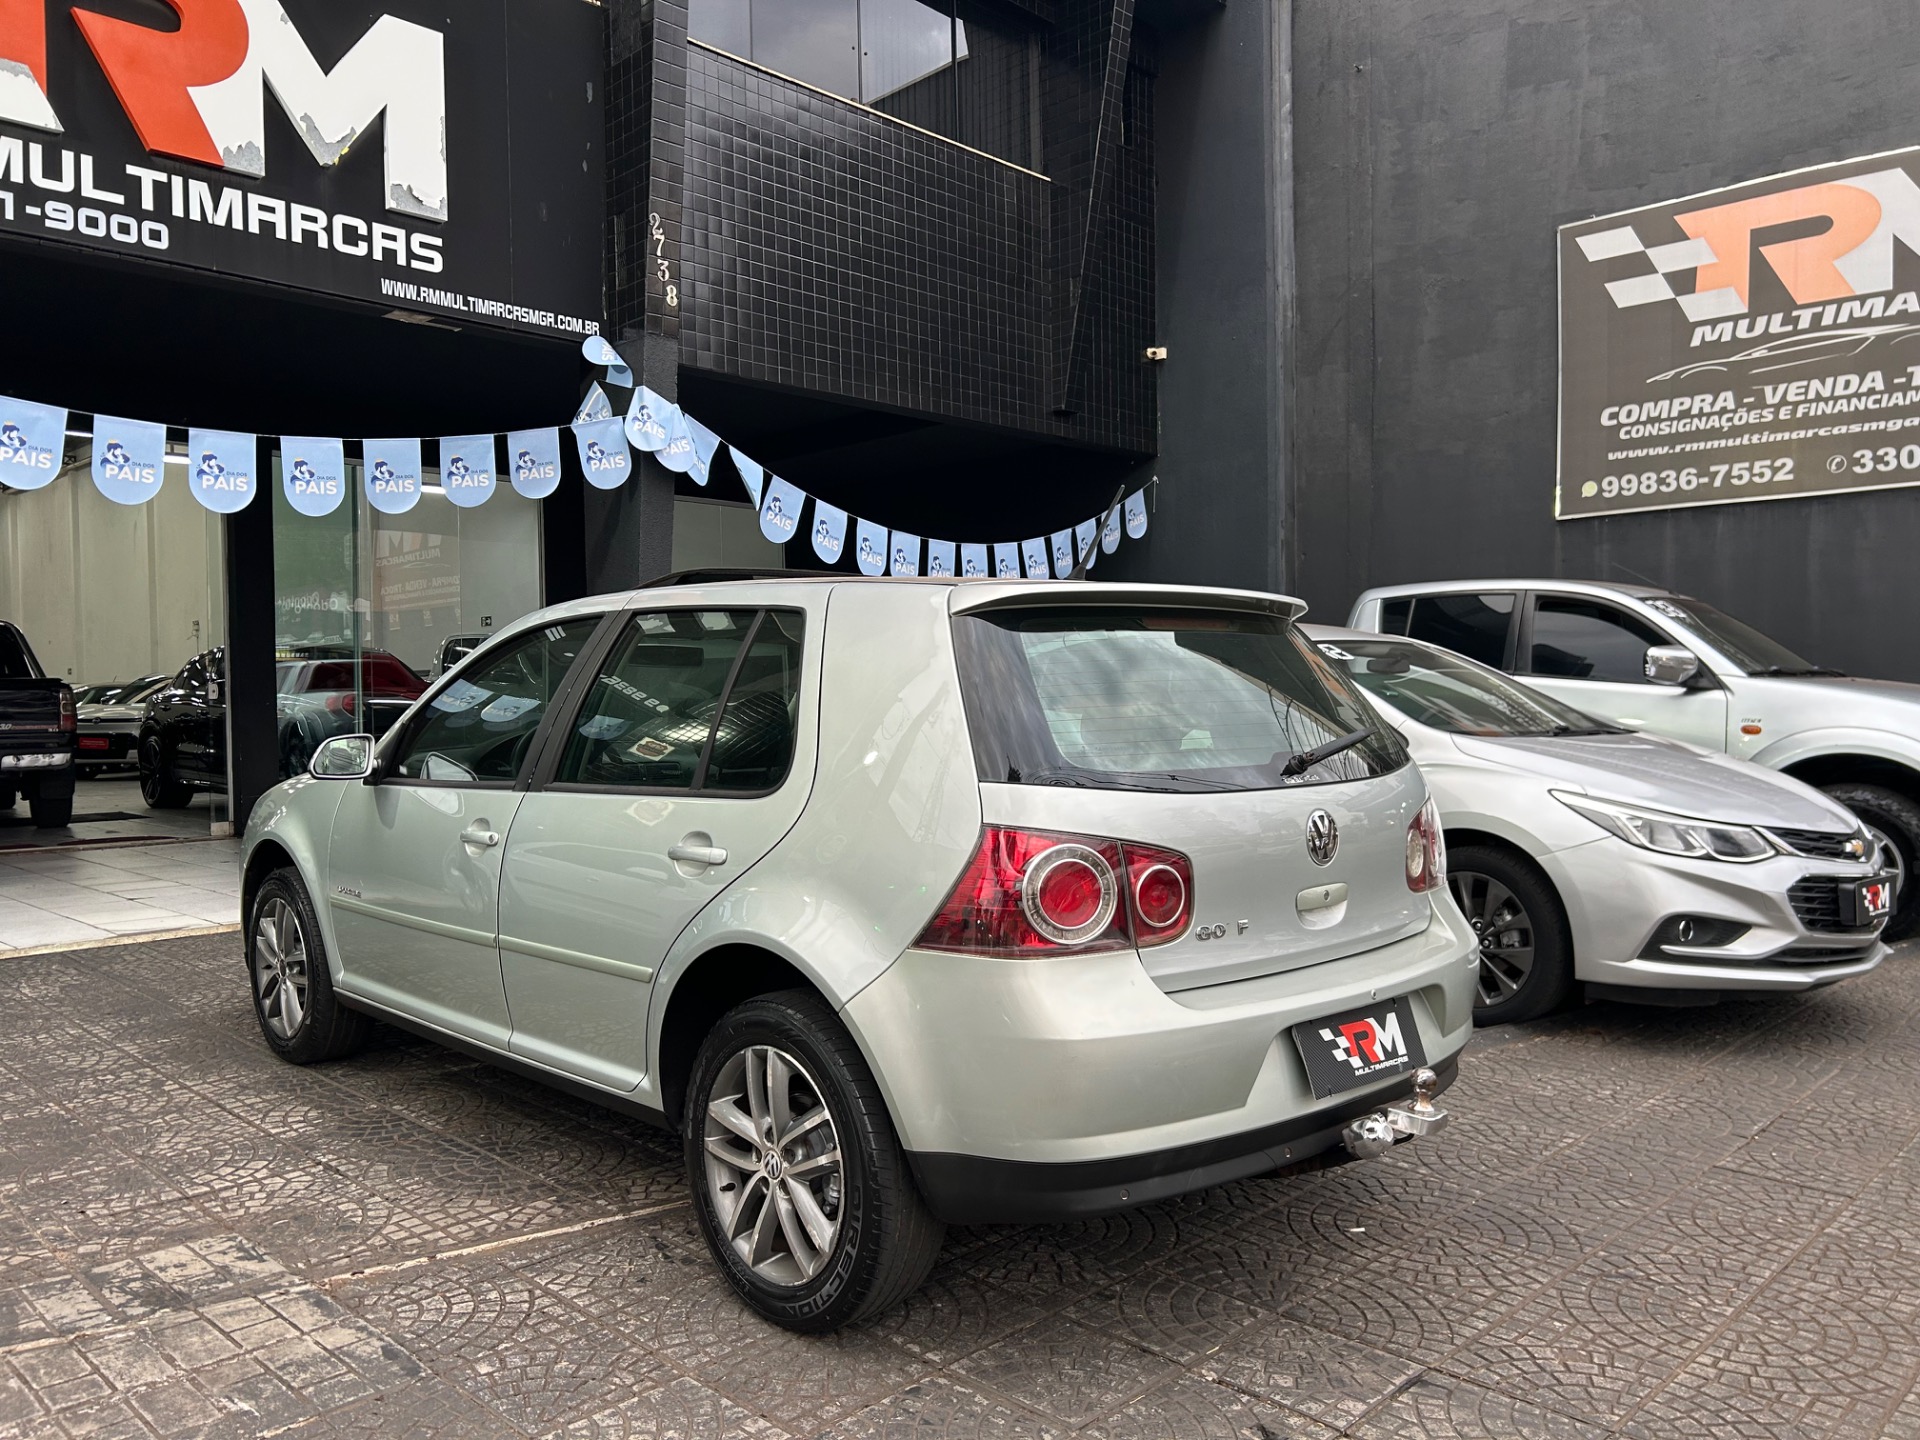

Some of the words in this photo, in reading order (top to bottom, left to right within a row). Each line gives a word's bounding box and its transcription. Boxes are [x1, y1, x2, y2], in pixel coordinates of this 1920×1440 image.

[649, 212, 678, 307] 2738
[380, 277, 600, 337] WWW.RMMULTIMARCASMGA.COM.BR
[1600, 390, 1735, 427] COMPRA
[1764, 370, 1885, 405] VENDA
[633, 421, 666, 439] PAIS
[1619, 407, 1774, 440] CONSIGNAÇÕES
[1778, 405, 1793, 420] E
[0, 446, 52, 469] PAIS
[590, 455, 626, 472] PAIS
[1852, 444, 1920, 474] 330
[105, 464, 155, 484] PAIS
[451, 474, 489, 488] PAIS
[520, 465, 555, 481] PAIS
[1601, 457, 1794, 498] 99836-7552
[202, 475, 249, 492] PAIS
[295, 480, 337, 495] PAIS
[375, 480, 415, 493] PAIS
[766, 510, 793, 531] PAIS
[817, 534, 839, 551] PAIS
[861, 551, 883, 567] PAIS
[895, 562, 915, 575] PAIS
[1354, 1055, 1409, 1077] MULTIMARCAS
